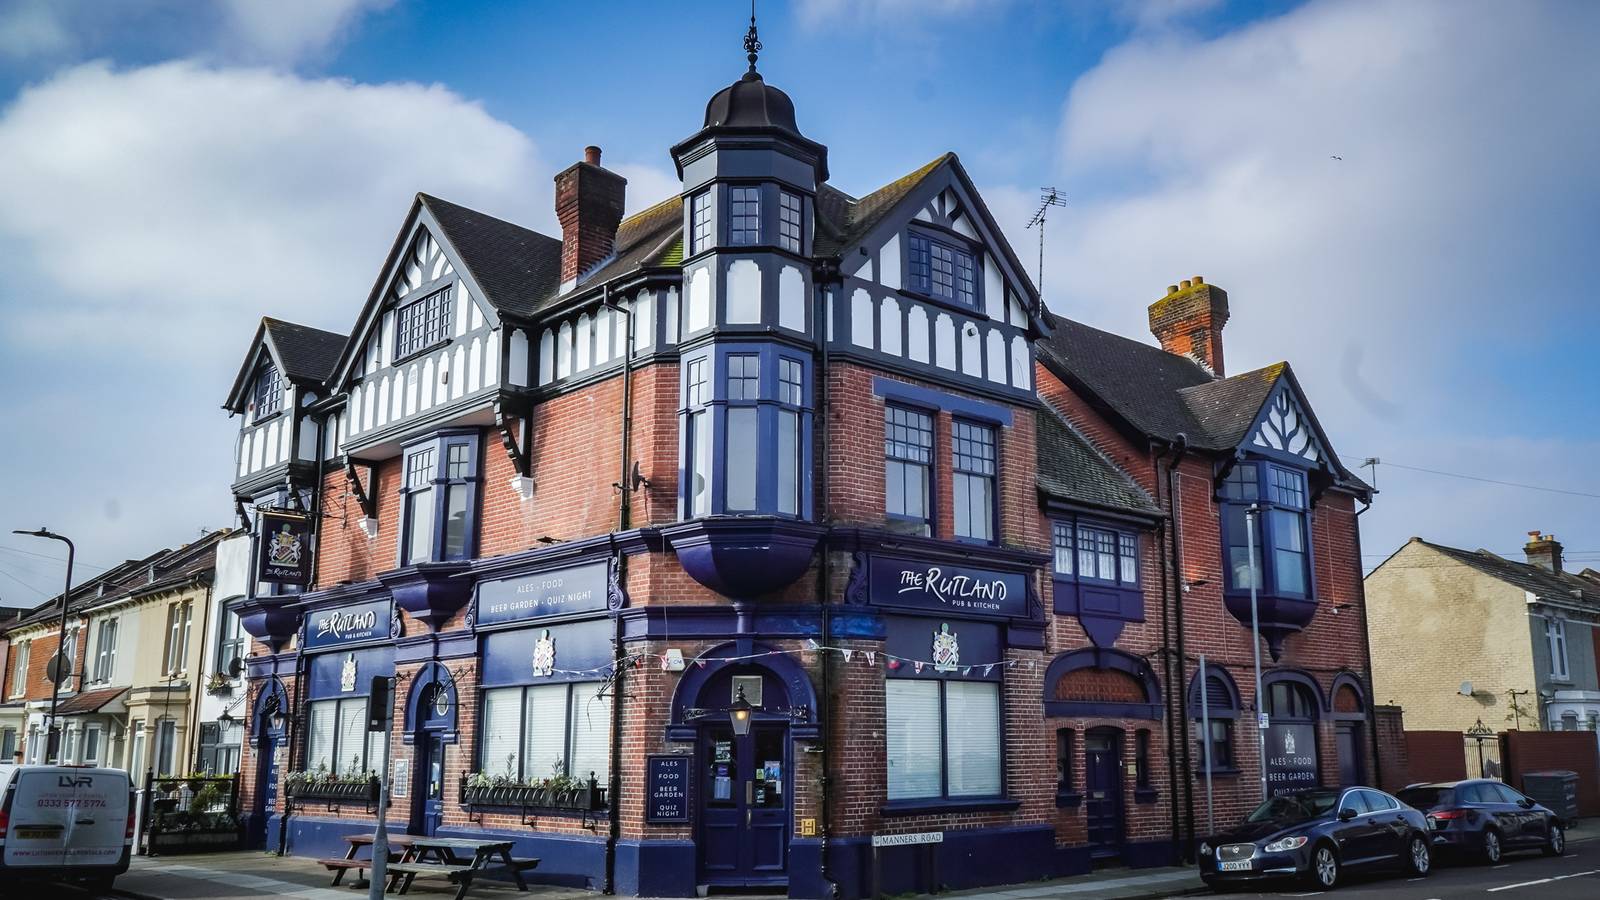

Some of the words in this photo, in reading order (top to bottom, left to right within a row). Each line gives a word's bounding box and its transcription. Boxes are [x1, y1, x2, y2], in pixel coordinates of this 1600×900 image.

[517, 584, 534, 594] ALES
[542, 580, 563, 589] FOOD
[925, 567, 1007, 603] RUTLAND
[490, 604, 507, 613] BEER
[510, 600, 539, 610] GARDEN
[547, 594, 565, 606] QUIZ
[568, 591, 592, 601] NIGHT
[952, 599, 965, 607] PUB
[973, 602, 1000, 610] KITCHEN
[330, 611, 375, 638] RUTLAND
[1270, 757, 1287, 766] ALES
[1293, 757, 1312, 765] FOOD
[1288, 772, 1315, 781] GARDEN
[882, 835, 917, 844] MANNERS
[922, 833, 941, 842] ROAD
